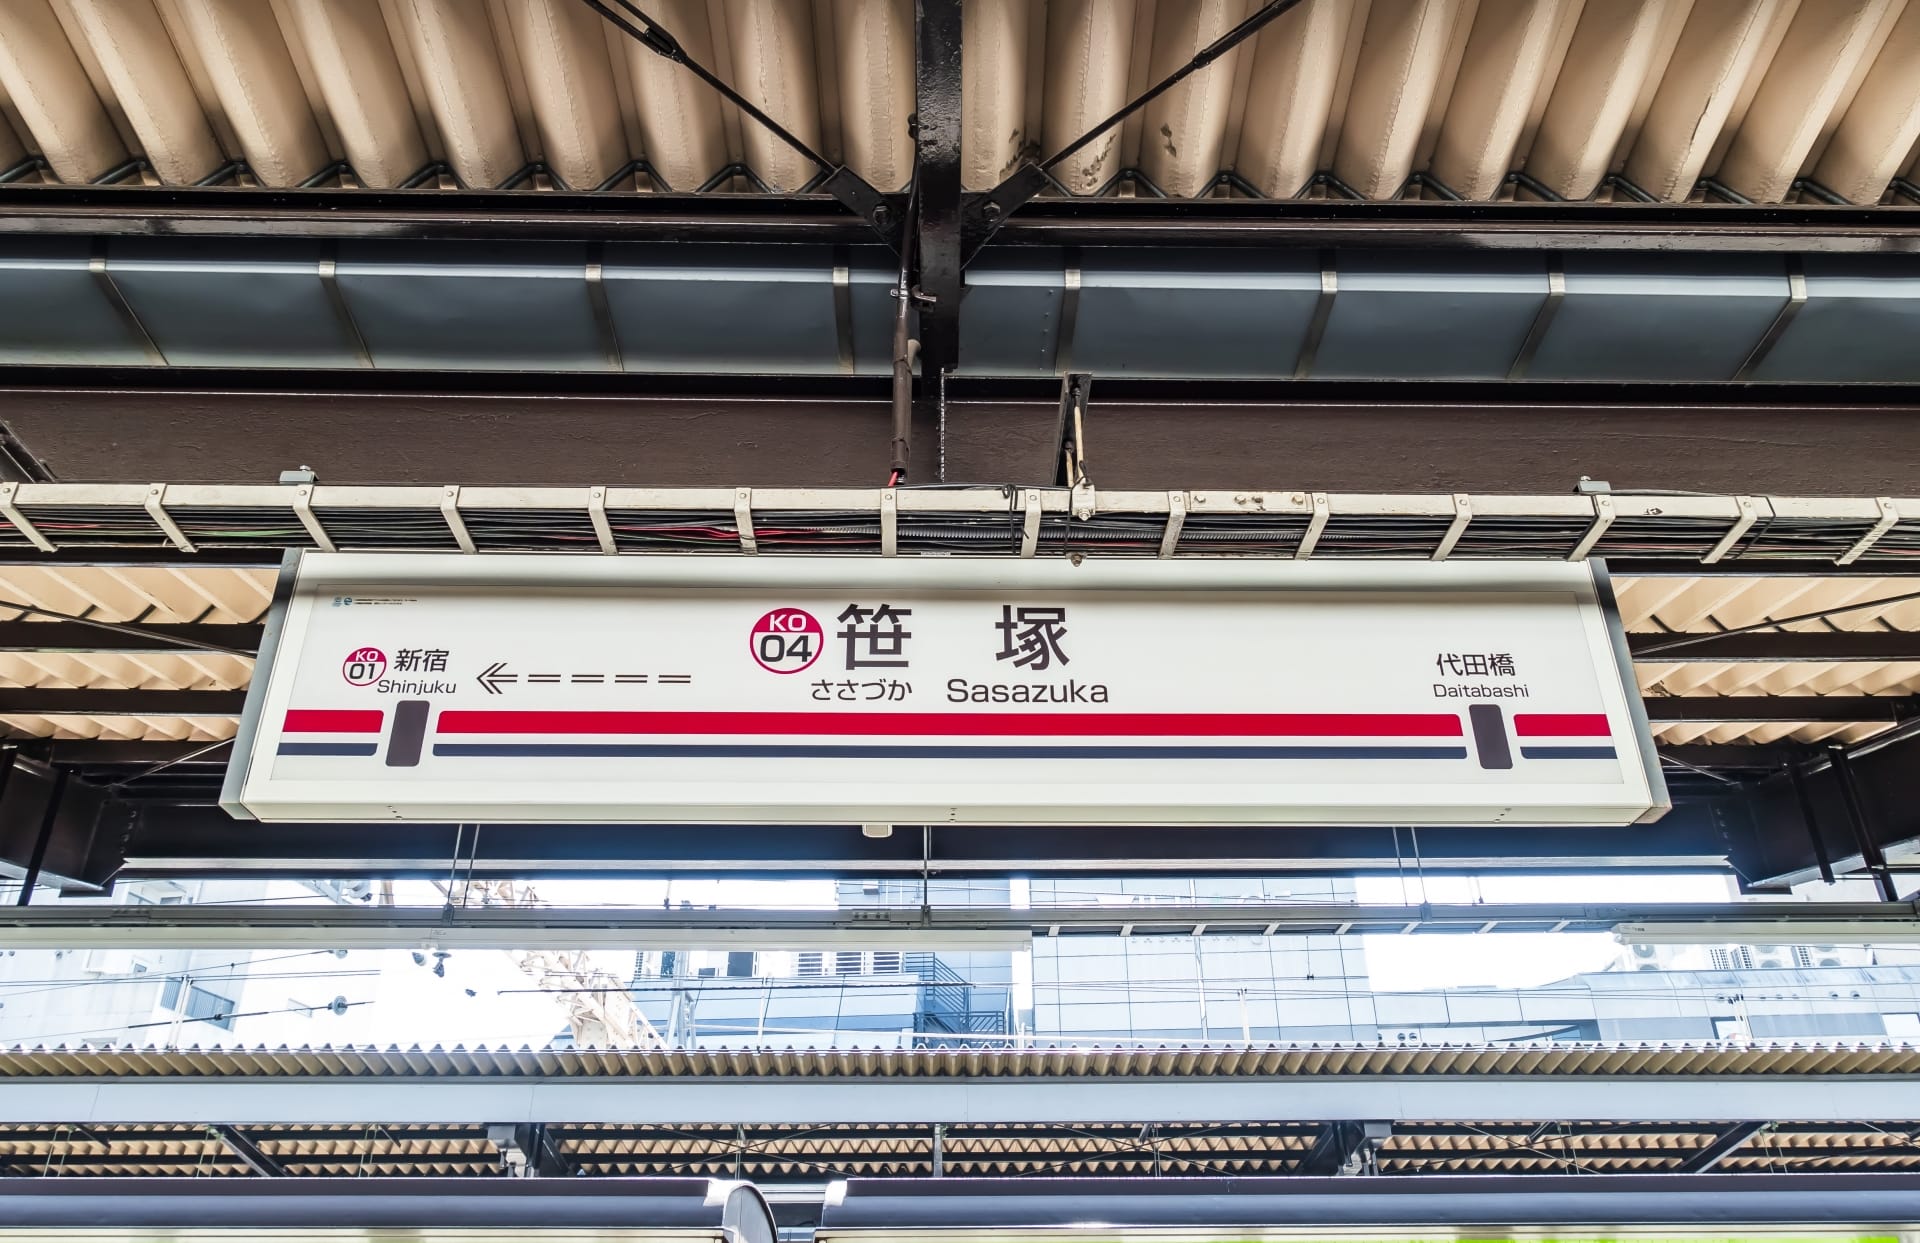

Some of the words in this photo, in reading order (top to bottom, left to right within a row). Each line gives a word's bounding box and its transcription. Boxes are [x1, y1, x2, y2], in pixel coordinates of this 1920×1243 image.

[769, 615, 806, 632] KO
[355, 650, 379, 662] KO
[760, 634, 813, 662] 04
[349, 662, 376, 680] 01
[393, 648, 450, 673] 新宿
[1436, 653, 1516, 677] 代田橋
[376, 679, 457, 696] Shinjuku
[811, 678, 913, 702] ささづか
[946, 678, 1109, 703] Sasazuka
[1432, 683, 1529, 698] Daitabashi
